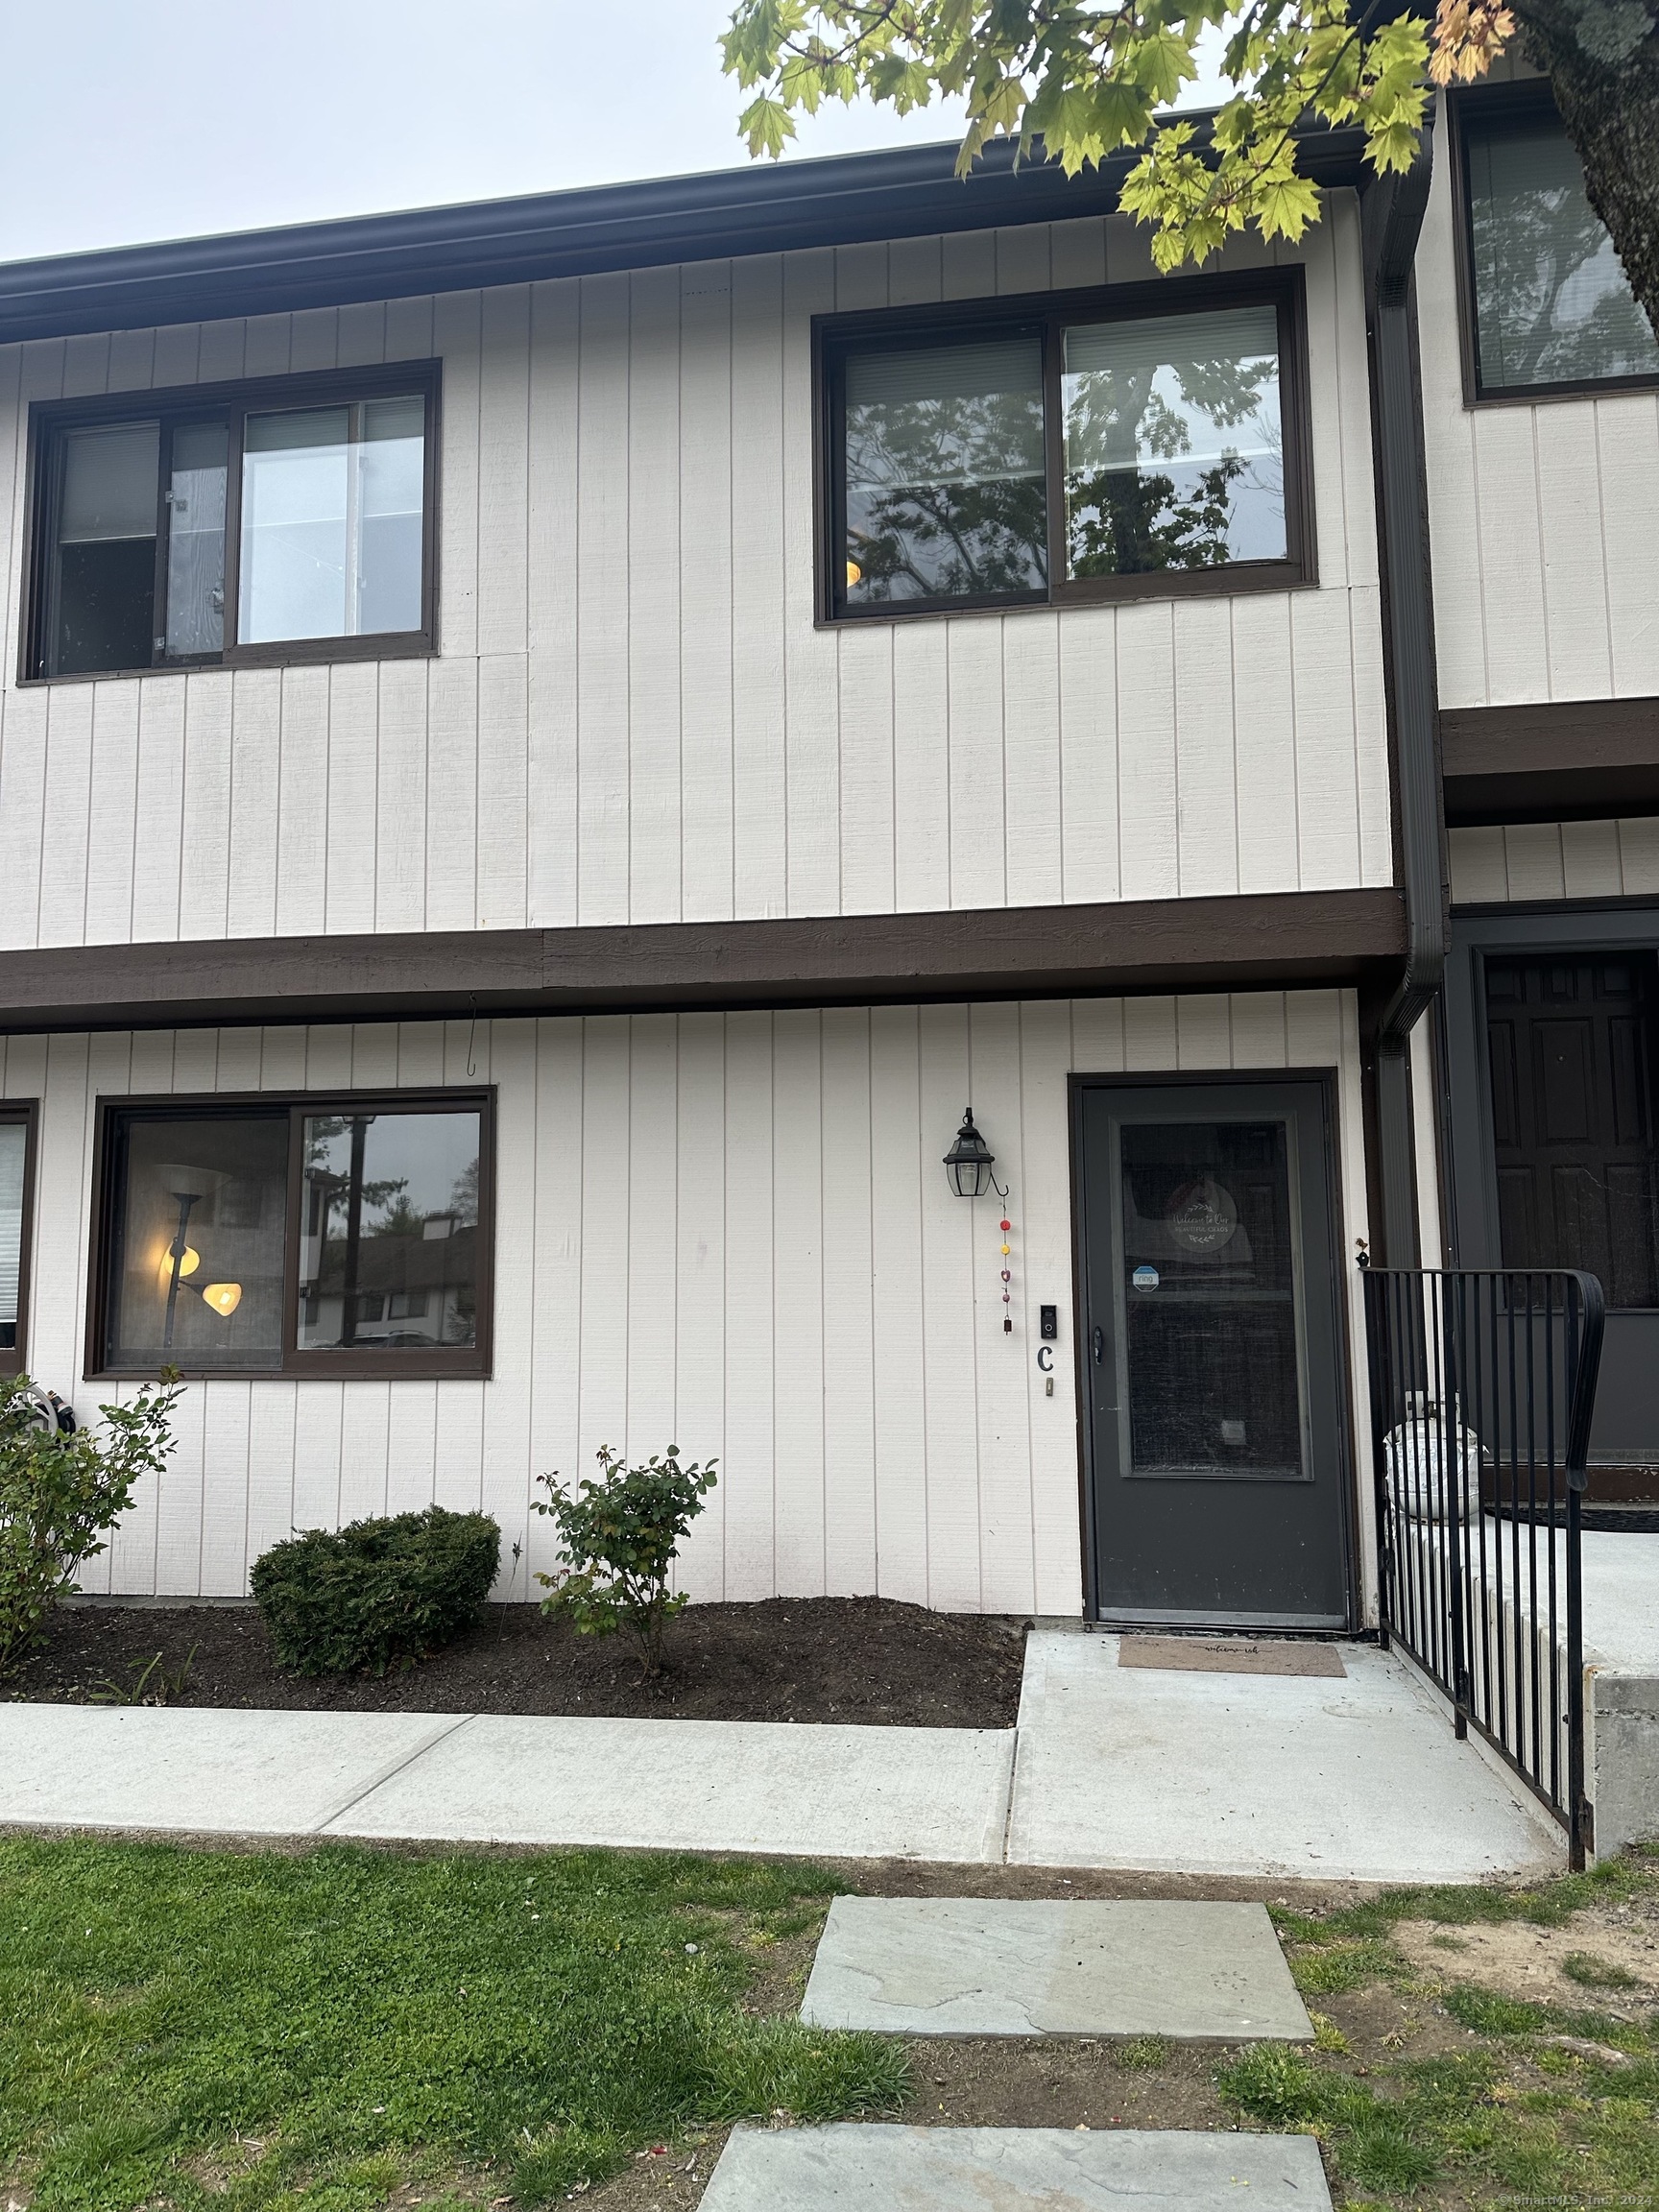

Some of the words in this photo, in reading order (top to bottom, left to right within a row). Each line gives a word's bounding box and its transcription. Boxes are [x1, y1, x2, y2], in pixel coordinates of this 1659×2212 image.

[1172, 1213, 1206, 1224] Welcome
[1214, 1213, 1230, 1225] Our
[1139, 1275, 1154, 1284] ring
[1037, 1346, 1054, 1372] C
